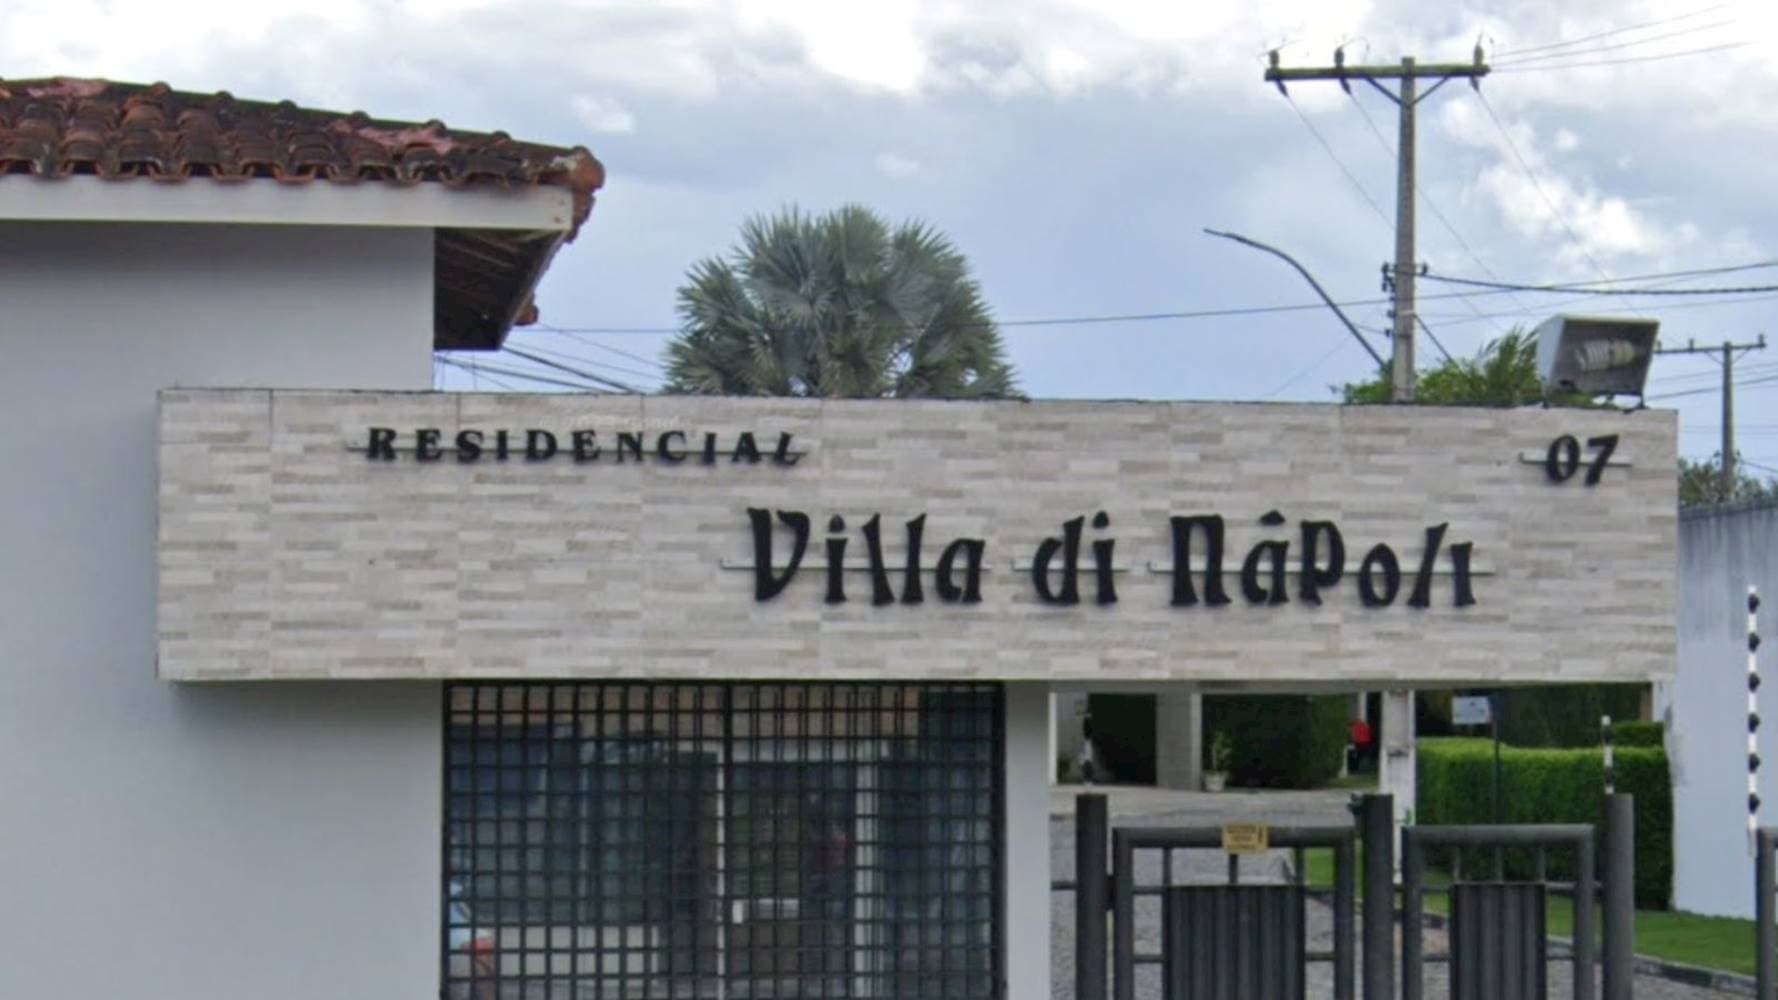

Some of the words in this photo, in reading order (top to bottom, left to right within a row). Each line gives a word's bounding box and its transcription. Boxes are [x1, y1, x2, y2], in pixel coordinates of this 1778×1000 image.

[367, 427, 804, 466] RESIDENCIAL
[1546, 434, 1619, 486] 07
[747, 507, 985, 607] Villa
[1031, 510, 1117, 606] di
